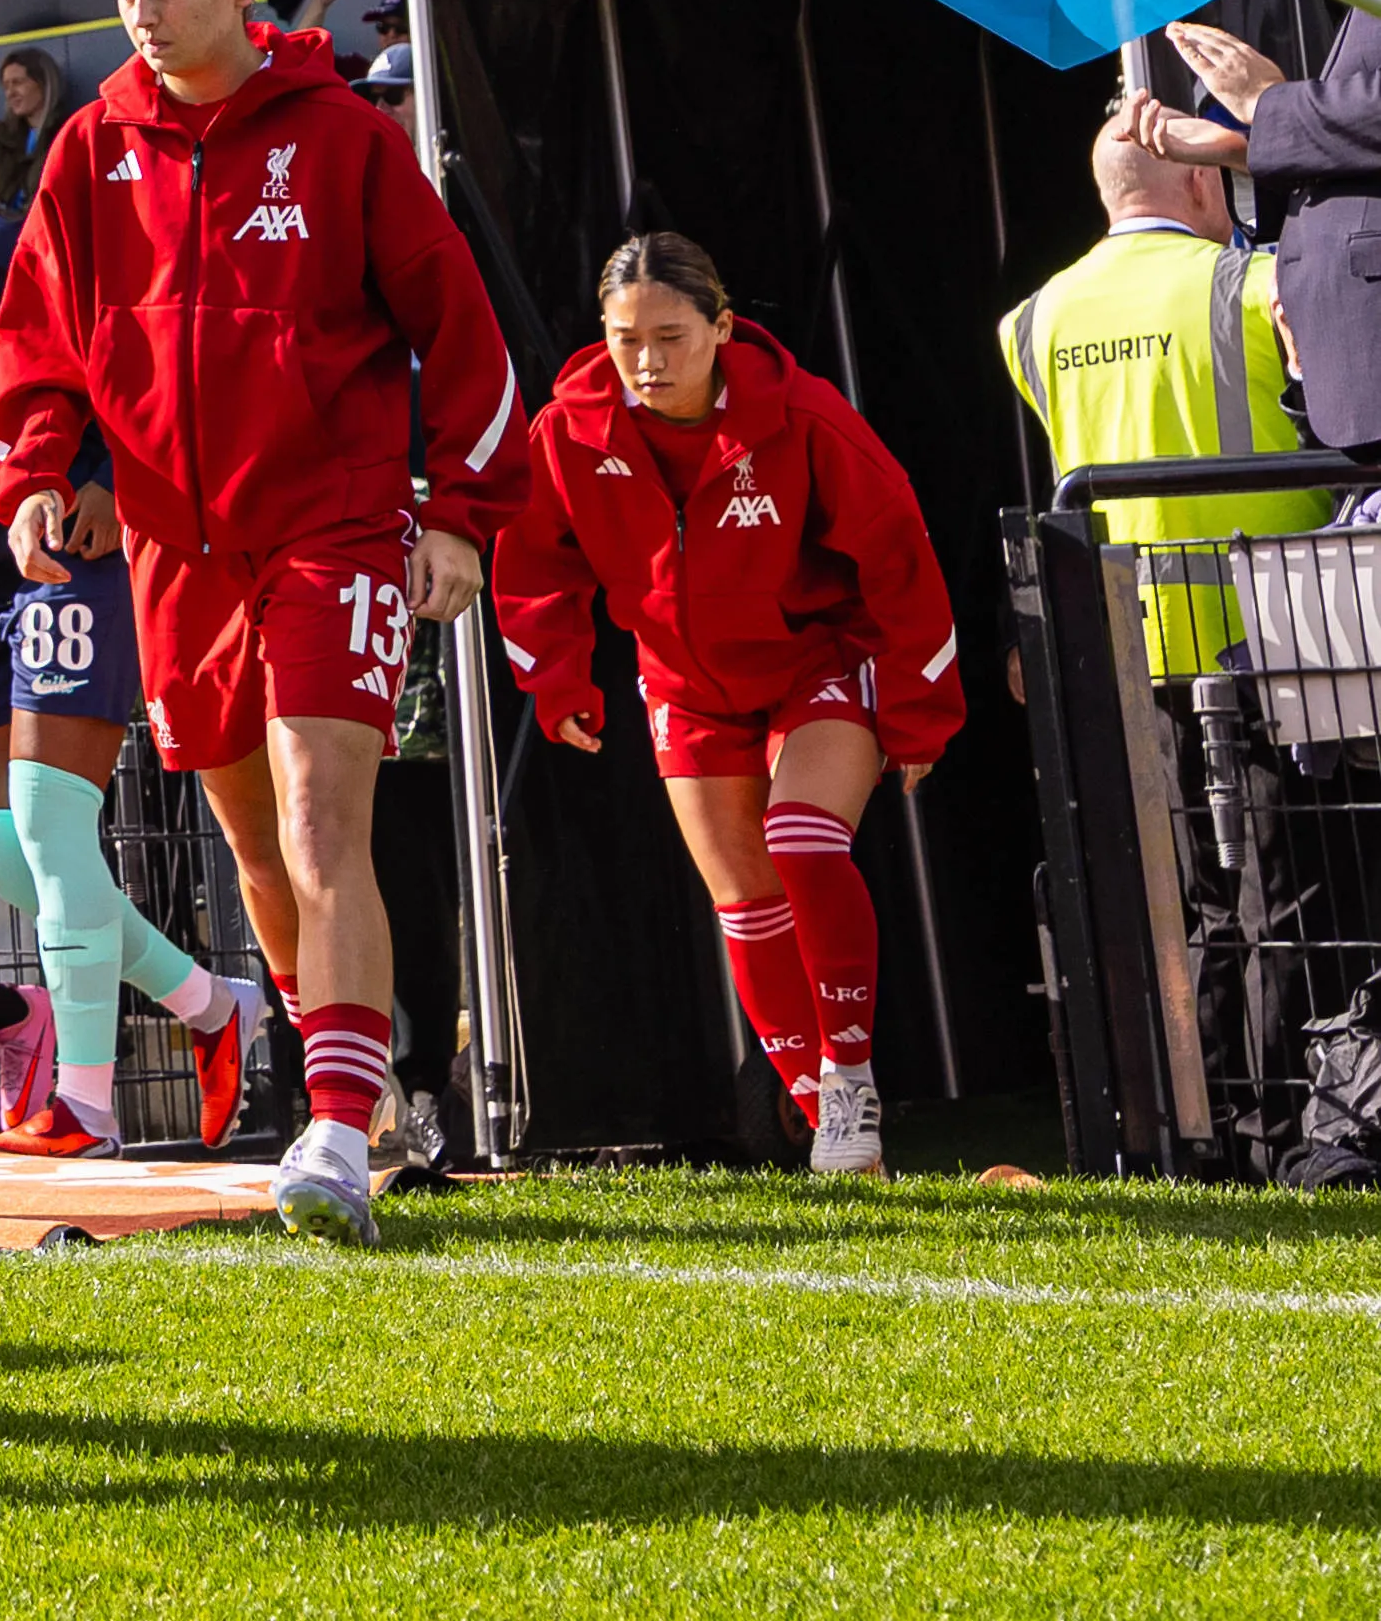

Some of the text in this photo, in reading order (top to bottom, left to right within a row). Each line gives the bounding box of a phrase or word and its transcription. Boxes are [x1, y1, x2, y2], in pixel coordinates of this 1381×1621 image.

[232, 204, 309, 241] AXA
[1056, 332, 1172, 371] SECURITY
[716, 495, 781, 529] AXA
[20, 602, 94, 671] 88
[339, 572, 409, 666] 13
[819, 982, 868, 1002] LFC
[760, 1034, 805, 1054] LFC
